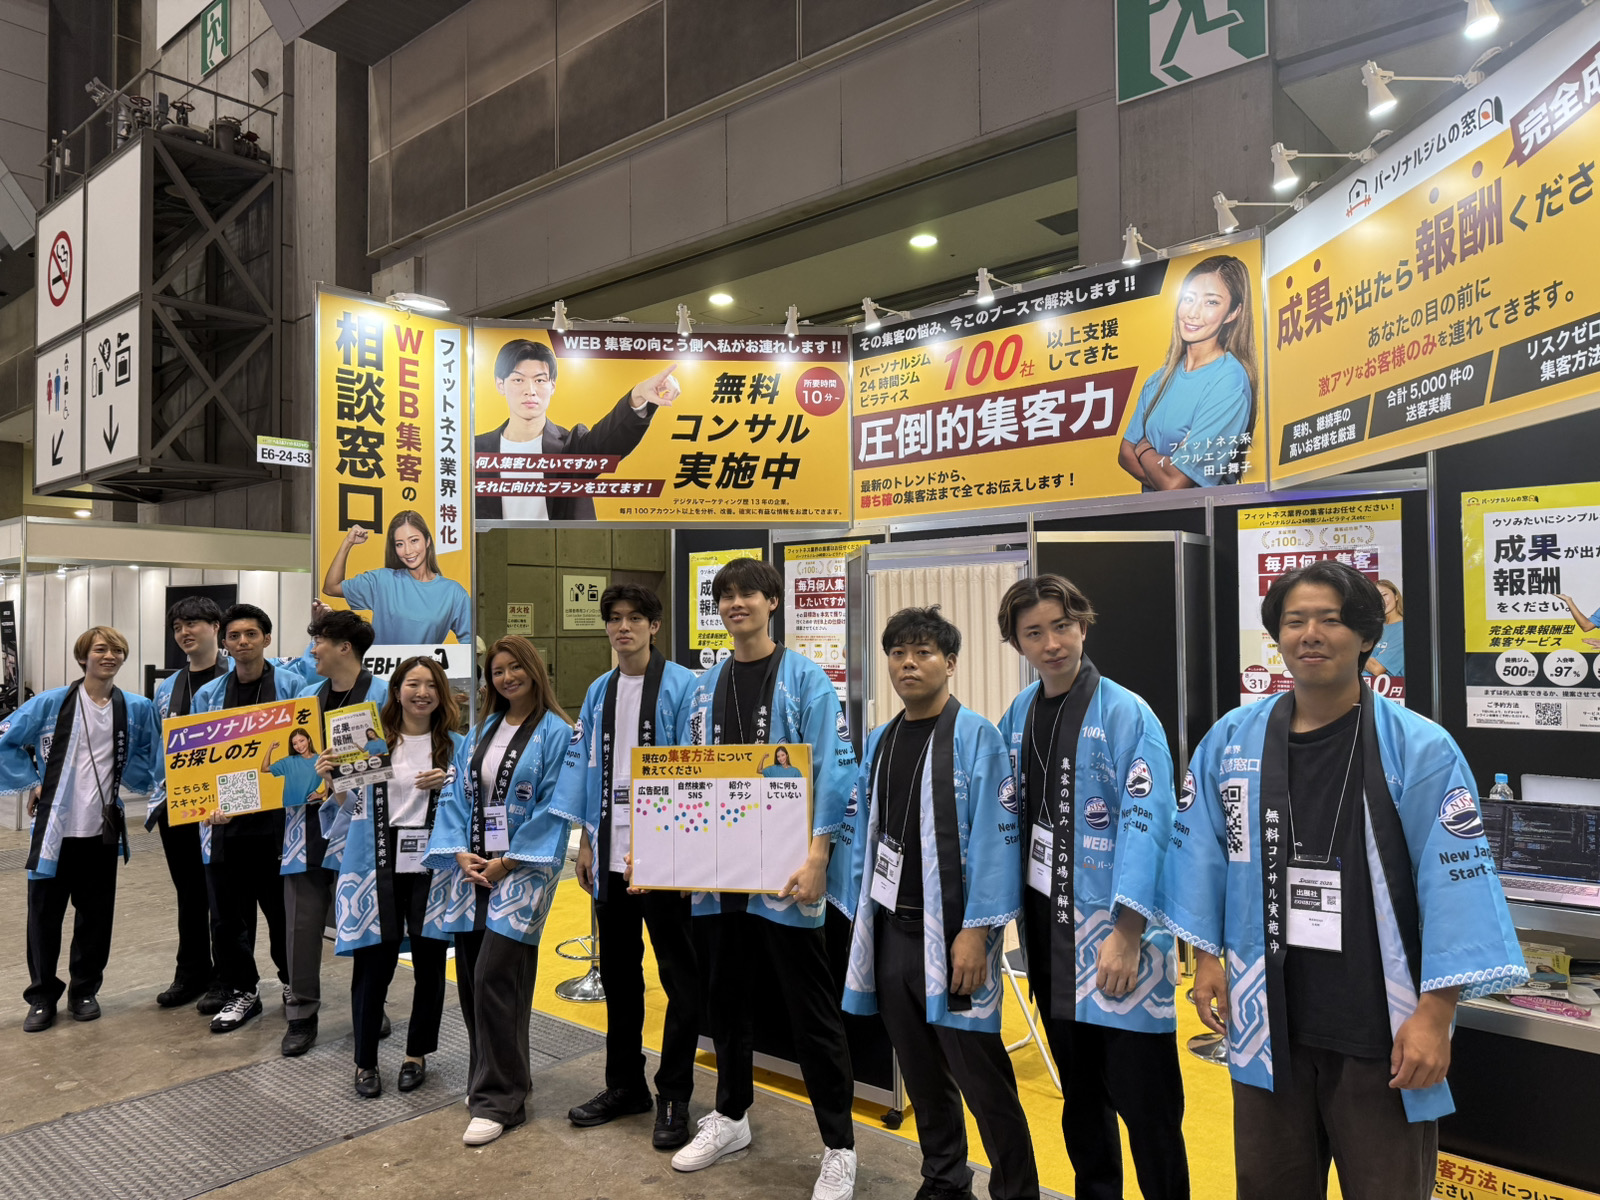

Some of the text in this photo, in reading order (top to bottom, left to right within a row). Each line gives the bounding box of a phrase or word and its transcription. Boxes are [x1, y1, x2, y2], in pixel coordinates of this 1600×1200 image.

[1368, 277, 1491, 348] あなたの目の前に
[1047, 317, 1119, 349] 以上支援
[1318, 280, 1575, 398] 激アツなお客様のみを連れてきます。
[563, 336, 601, 351] WEB
[859, 353, 931, 378] パーソナルジム
[943, 333, 1036, 391] 100社
[1048, 342, 1119, 371] してきた
[1540, 343, 1600, 382] 集客方法
[711, 372, 782, 405] 無料
[803, 379, 838, 389] 所要時間
[859, 371, 920, 393] 24 時間ジム
[1386, 364, 1474, 409] 合計 5,000 件の
[859, 389, 910, 409] ピラティス
[394, 324, 424, 502] WEB集客の
[1405, 395, 1452, 423] 送客実績
[336, 310, 386, 535] 相談窓口
[671, 413, 811, 444] コンサル
[858, 380, 1115, 463] 圧倒的集客力
[1292, 407, 1351, 439] 契約、継続率の
[1169, 431, 1252, 453] フィットネス系
[1289, 423, 1356, 459] 高いお客様を厳選
[261, 447, 311, 464] E6-24-53
[475, 456, 609, 472] 何人集客したいですか？
[1157, 448, 1252, 468] インフルエンサー
[673, 452, 801, 490] 実施中
[1203, 459, 1253, 477] 田上舞子
[474, 480, 653, 496] それに向けたプランを立てます！
[860, 469, 967, 493] 最新のトレンドから、
[860, 472, 1075, 509] 勝ち確の集客法まで全てお伝えします！
[673, 498, 749, 506] デジタルマーケティング歴
[619, 508, 633, 516] 毎月
[1244, 503, 1395, 521] フィットネス業界の集客はお任せください！
[1492, 513, 1600, 527] ウソみたいにシンプル
[1275, 537, 1297, 547] 100
[1493, 566, 1561, 596] 報酬
[1488, 624, 1576, 636] 完全成果報酬型
[1489, 637, 1563, 648] 集客サービス
[1503, 666, 1528, 677] 500
[168, 708, 312, 750] パーソナルジムを
[170, 739, 262, 770] お探しの方
[566, 751, 581, 760] apan
[642, 749, 753, 764] 現在の集客方法について
[838, 755, 858, 767] Start
[642, 765, 702, 776] 教えてください
[173, 781, 211, 796] こちらを
[638, 786, 669, 796] 広告配信
[677, 781, 713, 790] 自然検索や
[729, 781, 752, 790] 紹介や
[769, 781, 798, 790] 特に何も
[688, 791, 703, 799] SNS
[729, 791, 752, 799] チラシ
[766, 791, 802, 799] していない
[1451, 796, 1471, 811] NJS
[998, 822, 1016, 833] New
[1173, 820, 1190, 836] apan
[1056, 757, 1071, 924] 集客の悩み、この場で解決
[1097, 861, 1113, 869] パーソ
[1439, 850, 1470, 865] New
[1264, 808, 1280, 954] 無料コンサル実施中
